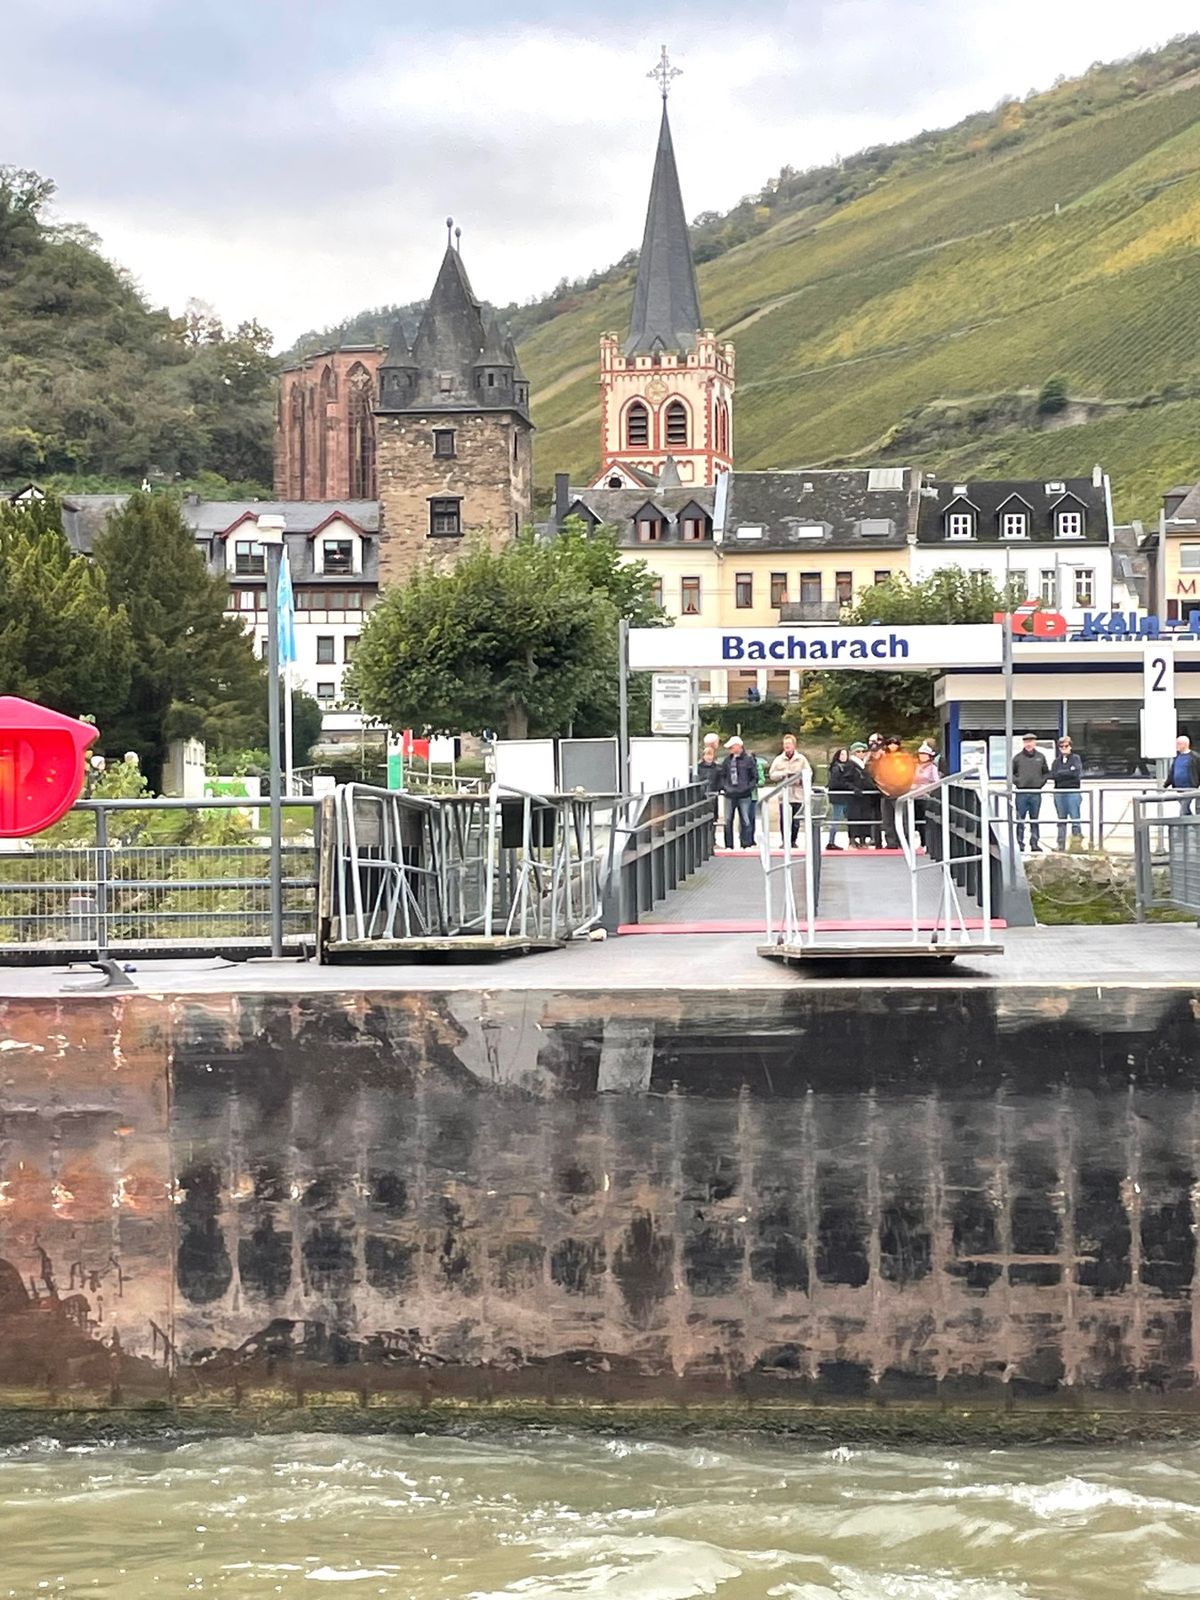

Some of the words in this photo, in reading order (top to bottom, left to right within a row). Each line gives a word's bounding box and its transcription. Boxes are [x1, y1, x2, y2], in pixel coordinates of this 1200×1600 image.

[1177, 579, 1196, 594] M
[722, 634, 909, 659] Bacharach
[1152, 658, 1167, 692] 2
